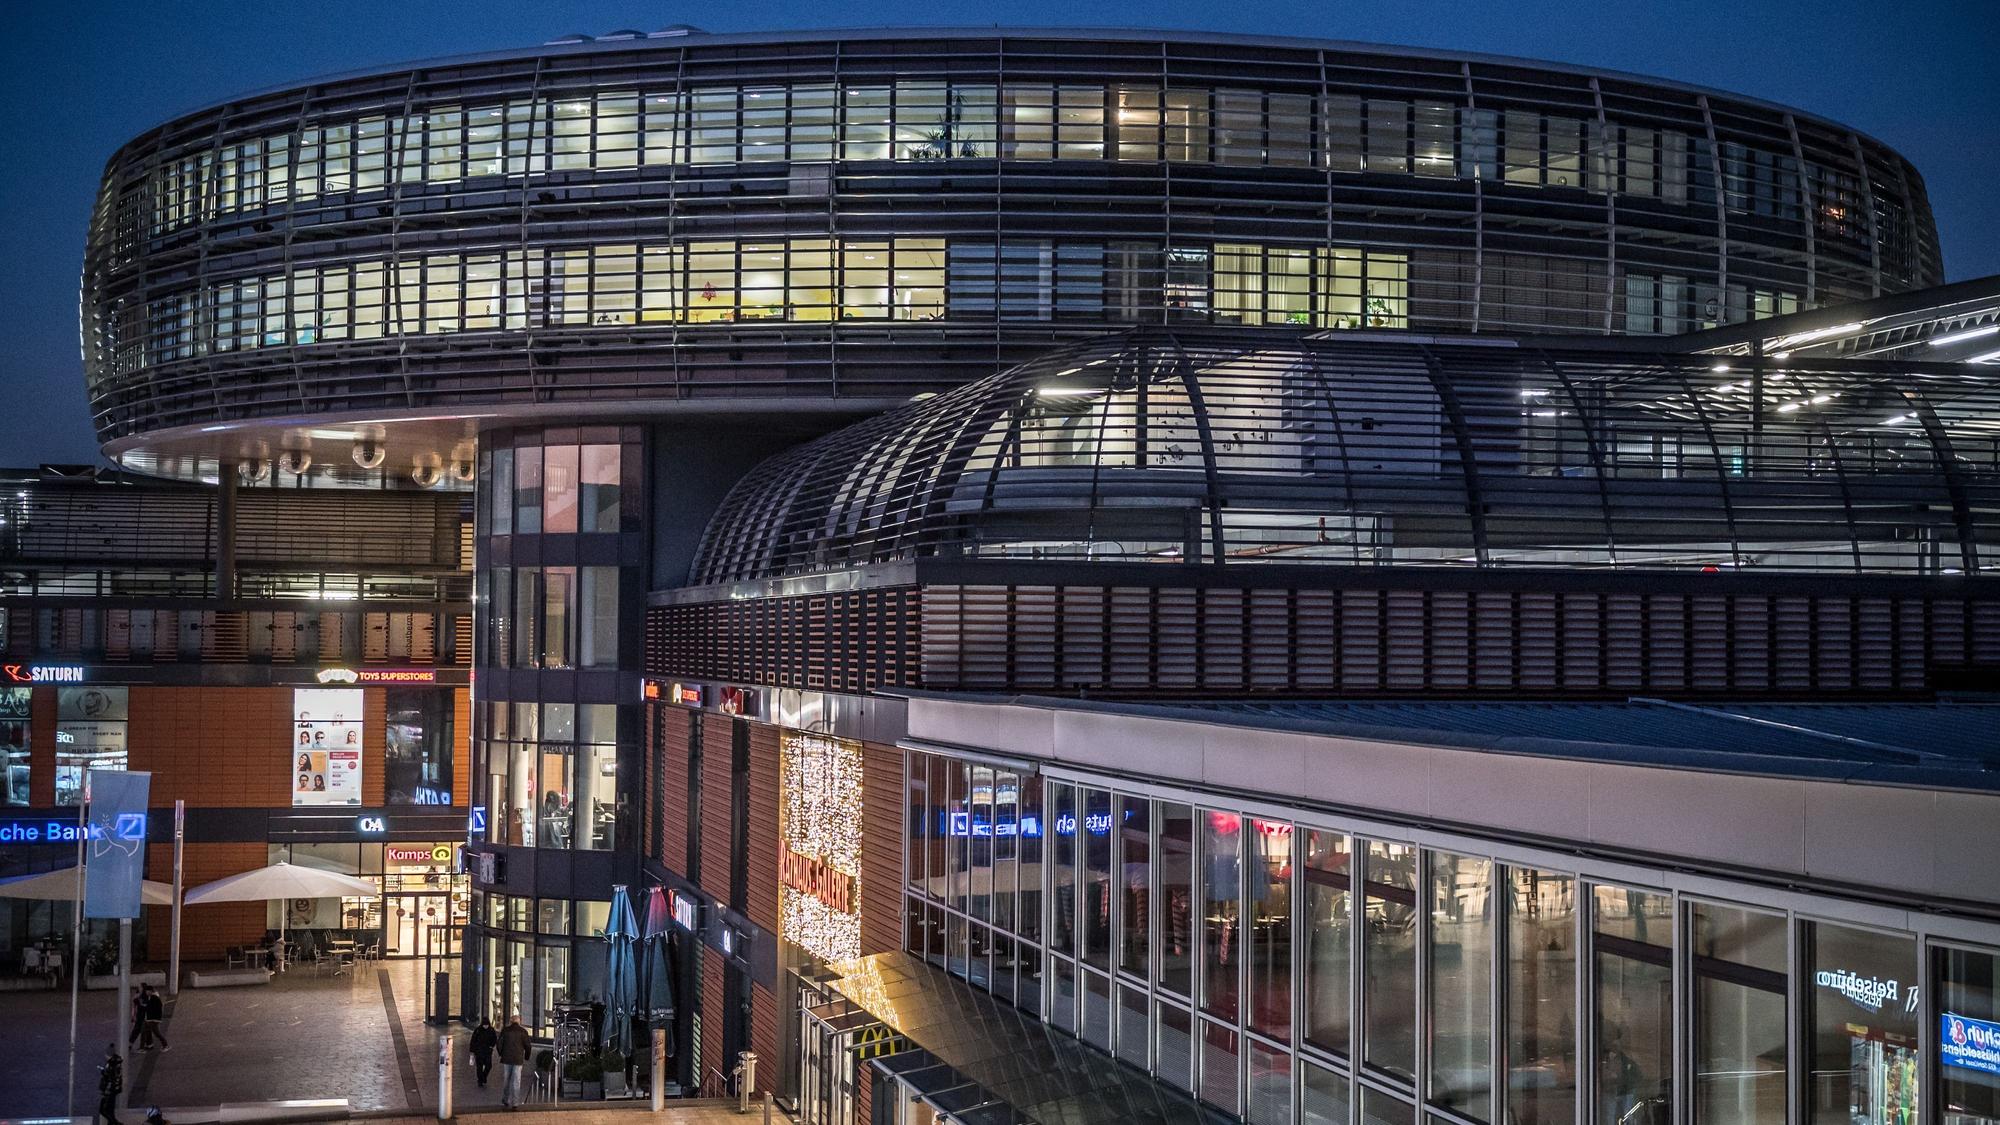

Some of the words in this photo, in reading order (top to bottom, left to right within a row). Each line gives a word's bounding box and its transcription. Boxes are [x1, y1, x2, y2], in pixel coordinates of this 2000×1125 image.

[32, 667, 83, 681] SATURN
[360, 672, 379, 680] TOYS
[381, 672, 434, 681] SUPERSTORES
[0, 823, 39, 840] che
[47, 822, 102, 840] Bank
[388, 849, 431, 861] Kamps
